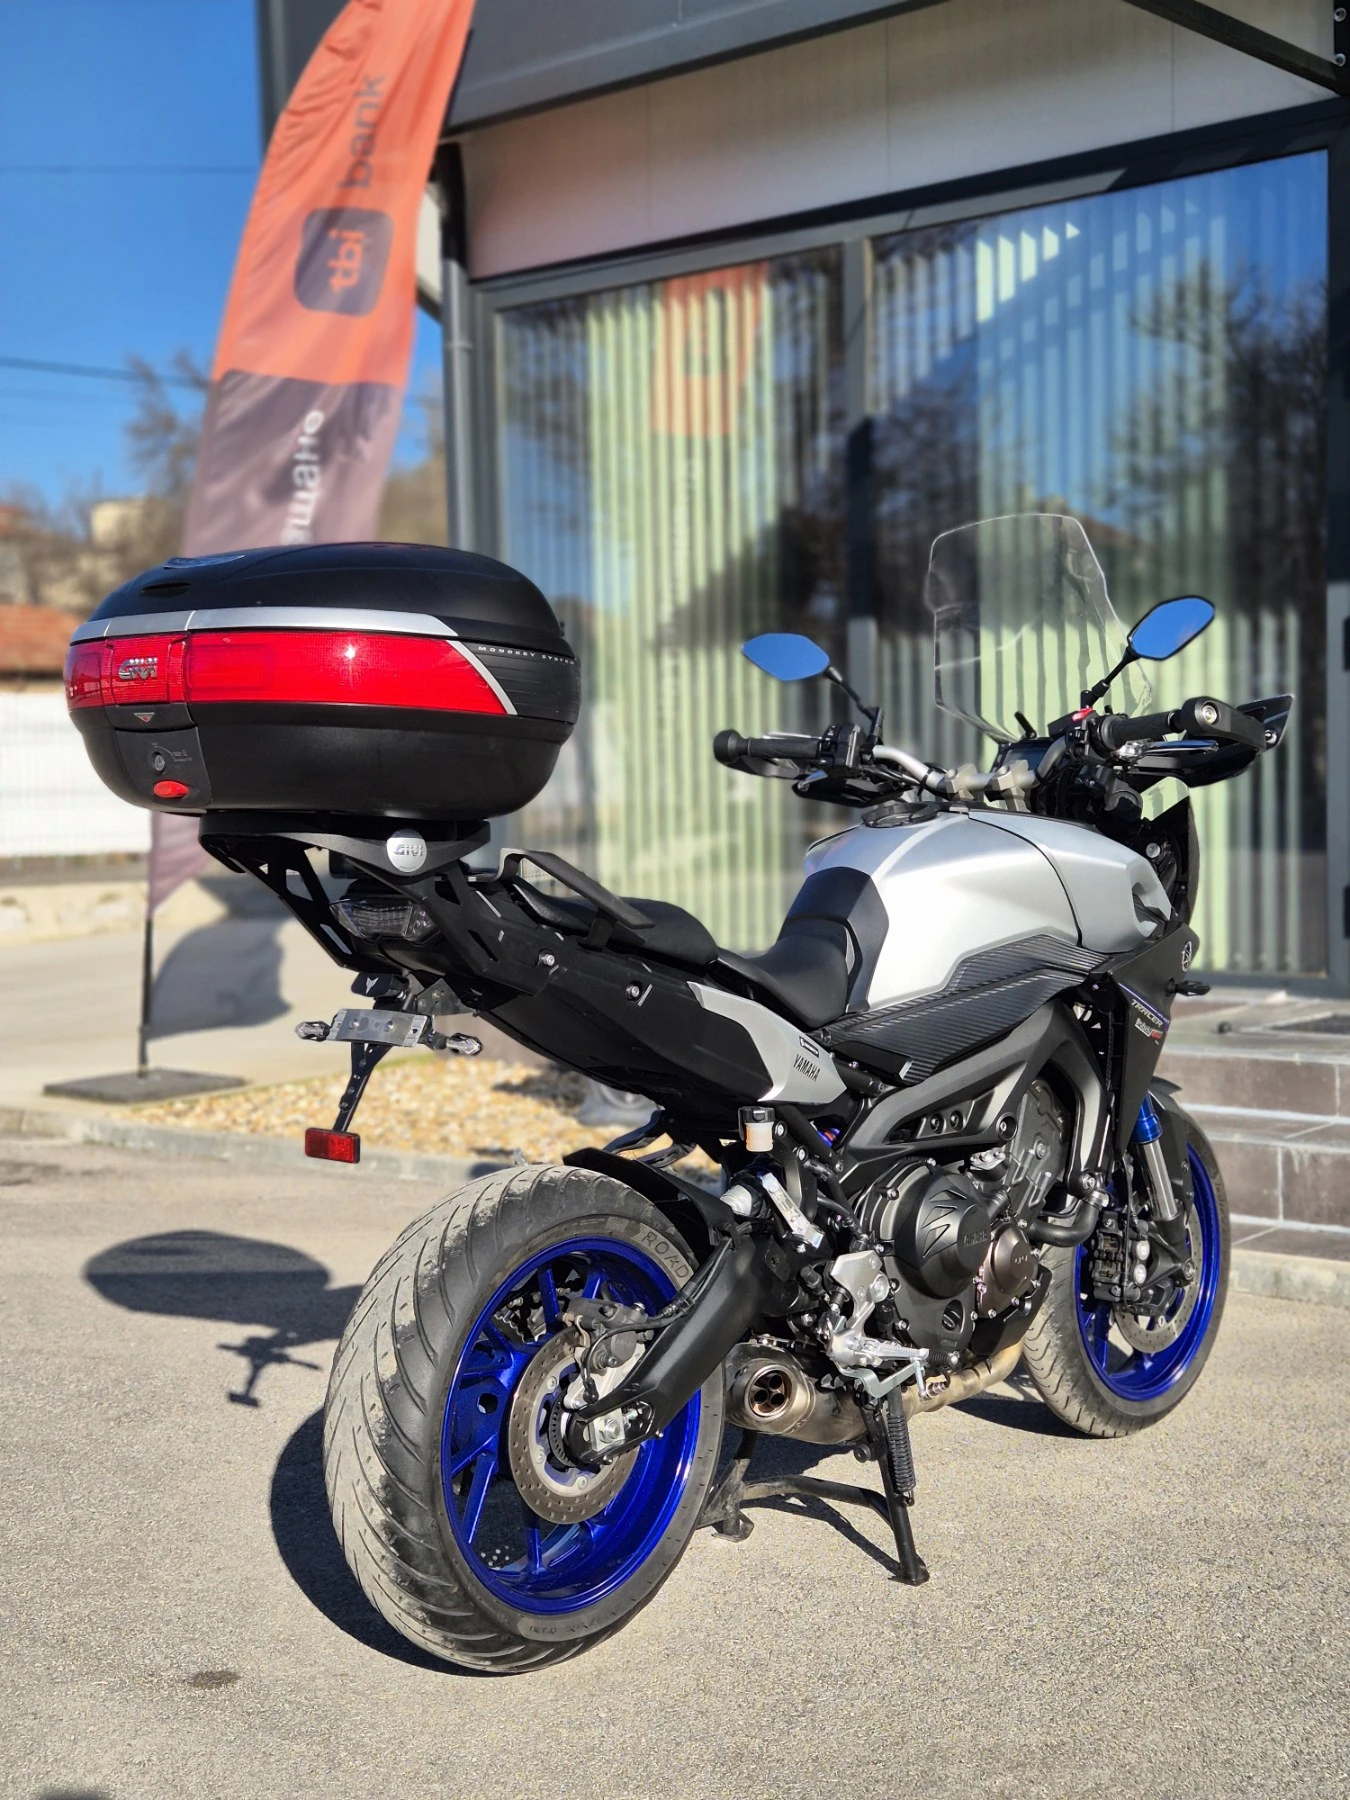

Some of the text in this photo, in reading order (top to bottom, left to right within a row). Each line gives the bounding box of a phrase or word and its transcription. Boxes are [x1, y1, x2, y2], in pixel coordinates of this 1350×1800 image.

[327, 73, 387, 292] tbi bank
[478, 646, 536, 658] MONOKEY
[118, 657, 158, 680] GIVI
[393, 843, 424, 857] GIVI
[1131, 998, 1164, 1028] TRACER
[793, 1053, 821, 1083] YAMAHA
[641, 1230, 690, 1279] ROAD
